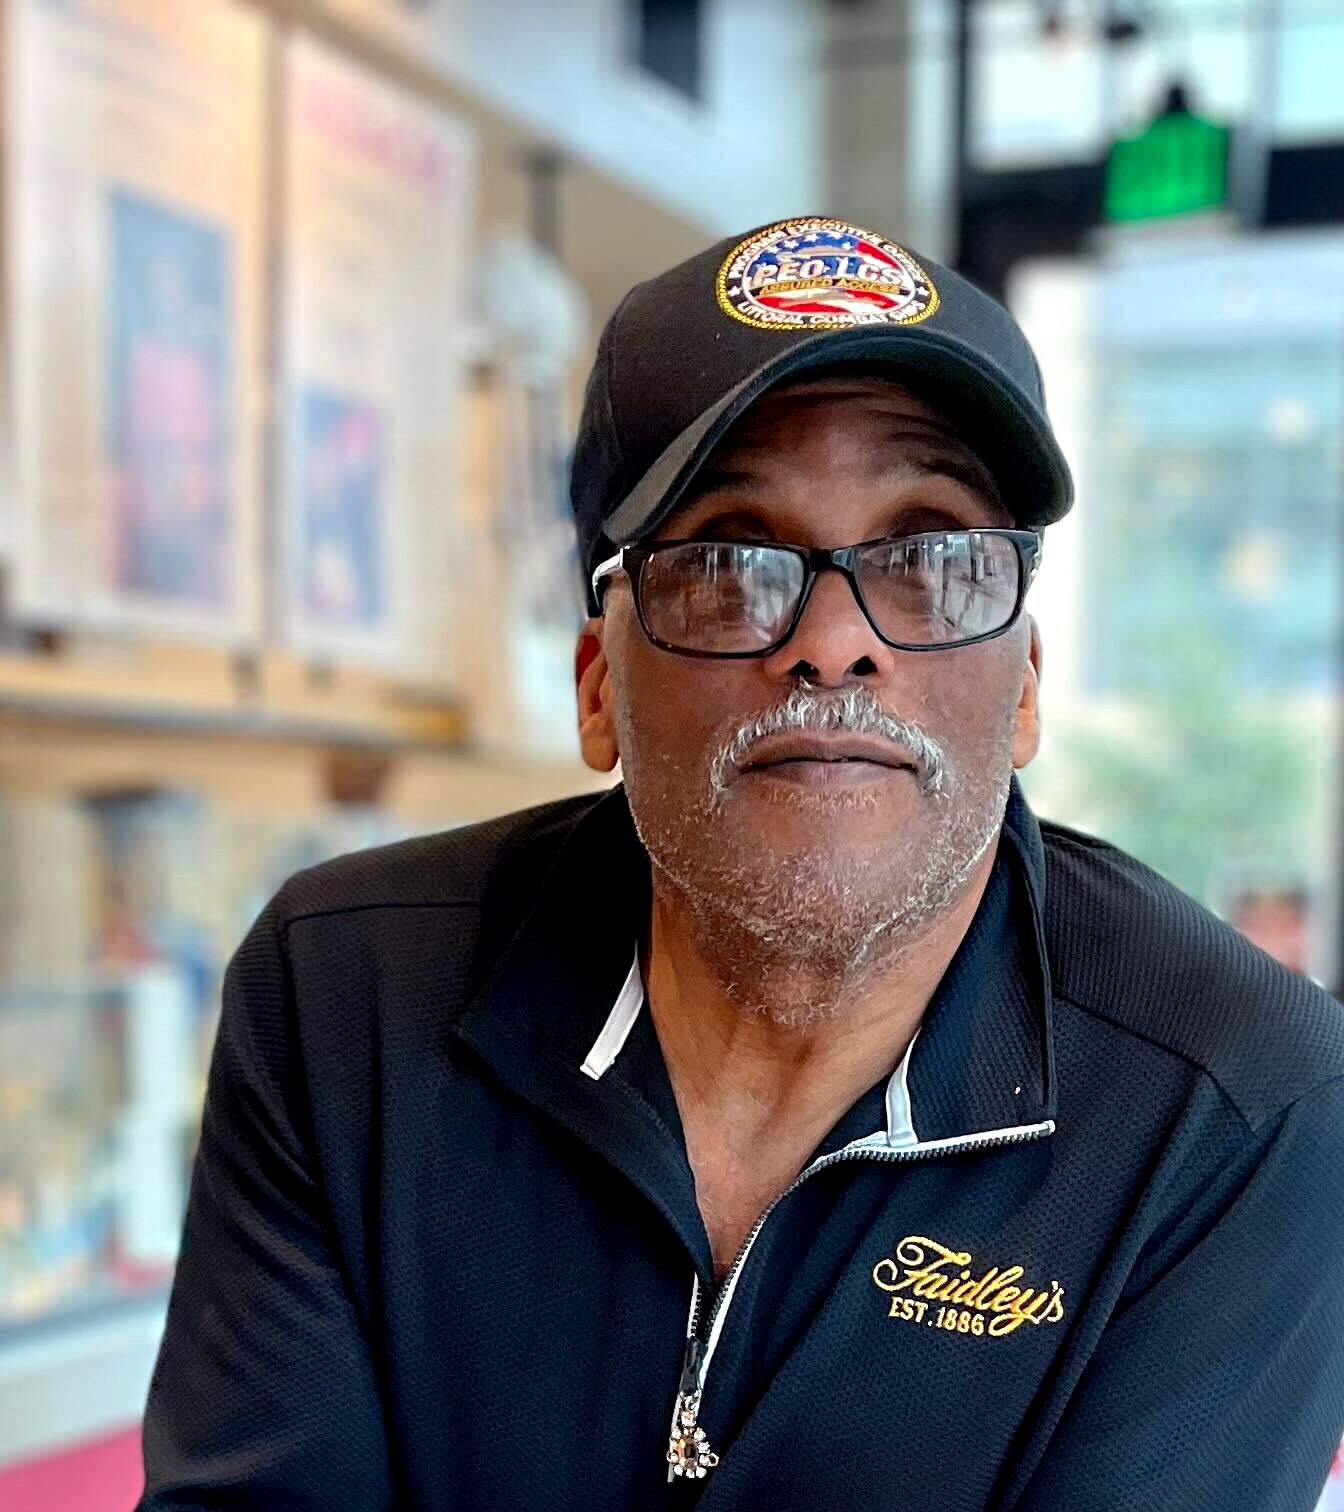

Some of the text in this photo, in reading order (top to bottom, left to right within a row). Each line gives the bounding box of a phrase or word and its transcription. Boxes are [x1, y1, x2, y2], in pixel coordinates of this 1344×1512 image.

[786, 222, 883, 247] EXECUTIVE
[750, 256, 904, 288] PEO LCS
[873, 1236, 1065, 1336] Faidley's
